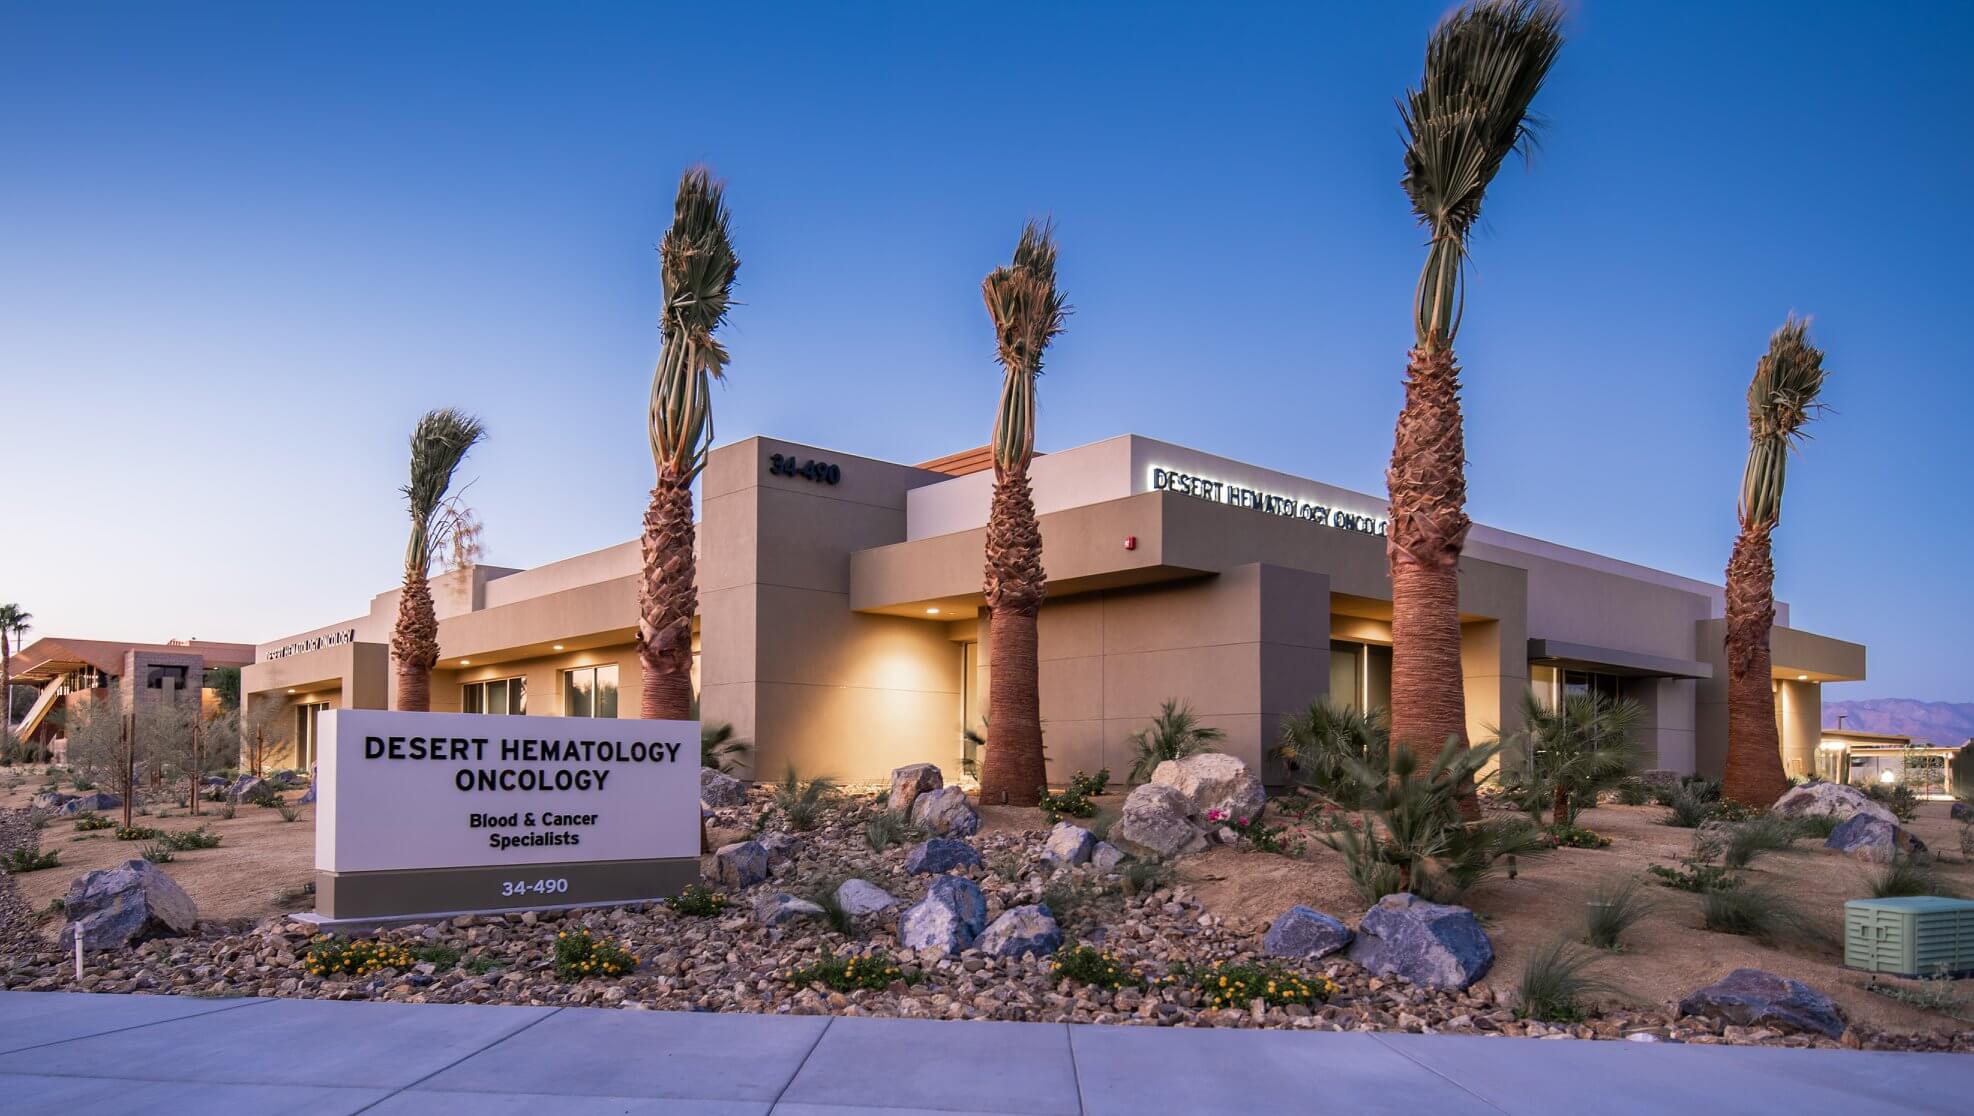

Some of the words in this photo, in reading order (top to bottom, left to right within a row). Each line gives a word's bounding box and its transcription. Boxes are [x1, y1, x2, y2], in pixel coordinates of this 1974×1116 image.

[769, 453, 841, 485] 34-490
[1153, 467, 1223, 502] DESERT
[1227, 485, 1331, 527] HEMATOLOGY
[365, 736, 488, 761] DESERT
[501, 739, 681, 763] HEMATOLOGY
[455, 769, 610, 791] ONCOLOGY
[470, 813, 518, 828] Blood
[524, 813, 536, 827] &
[542, 812, 598, 827] Cancer
[489, 832, 579, 850] Specialists
[501, 878, 568, 896] 34-490
